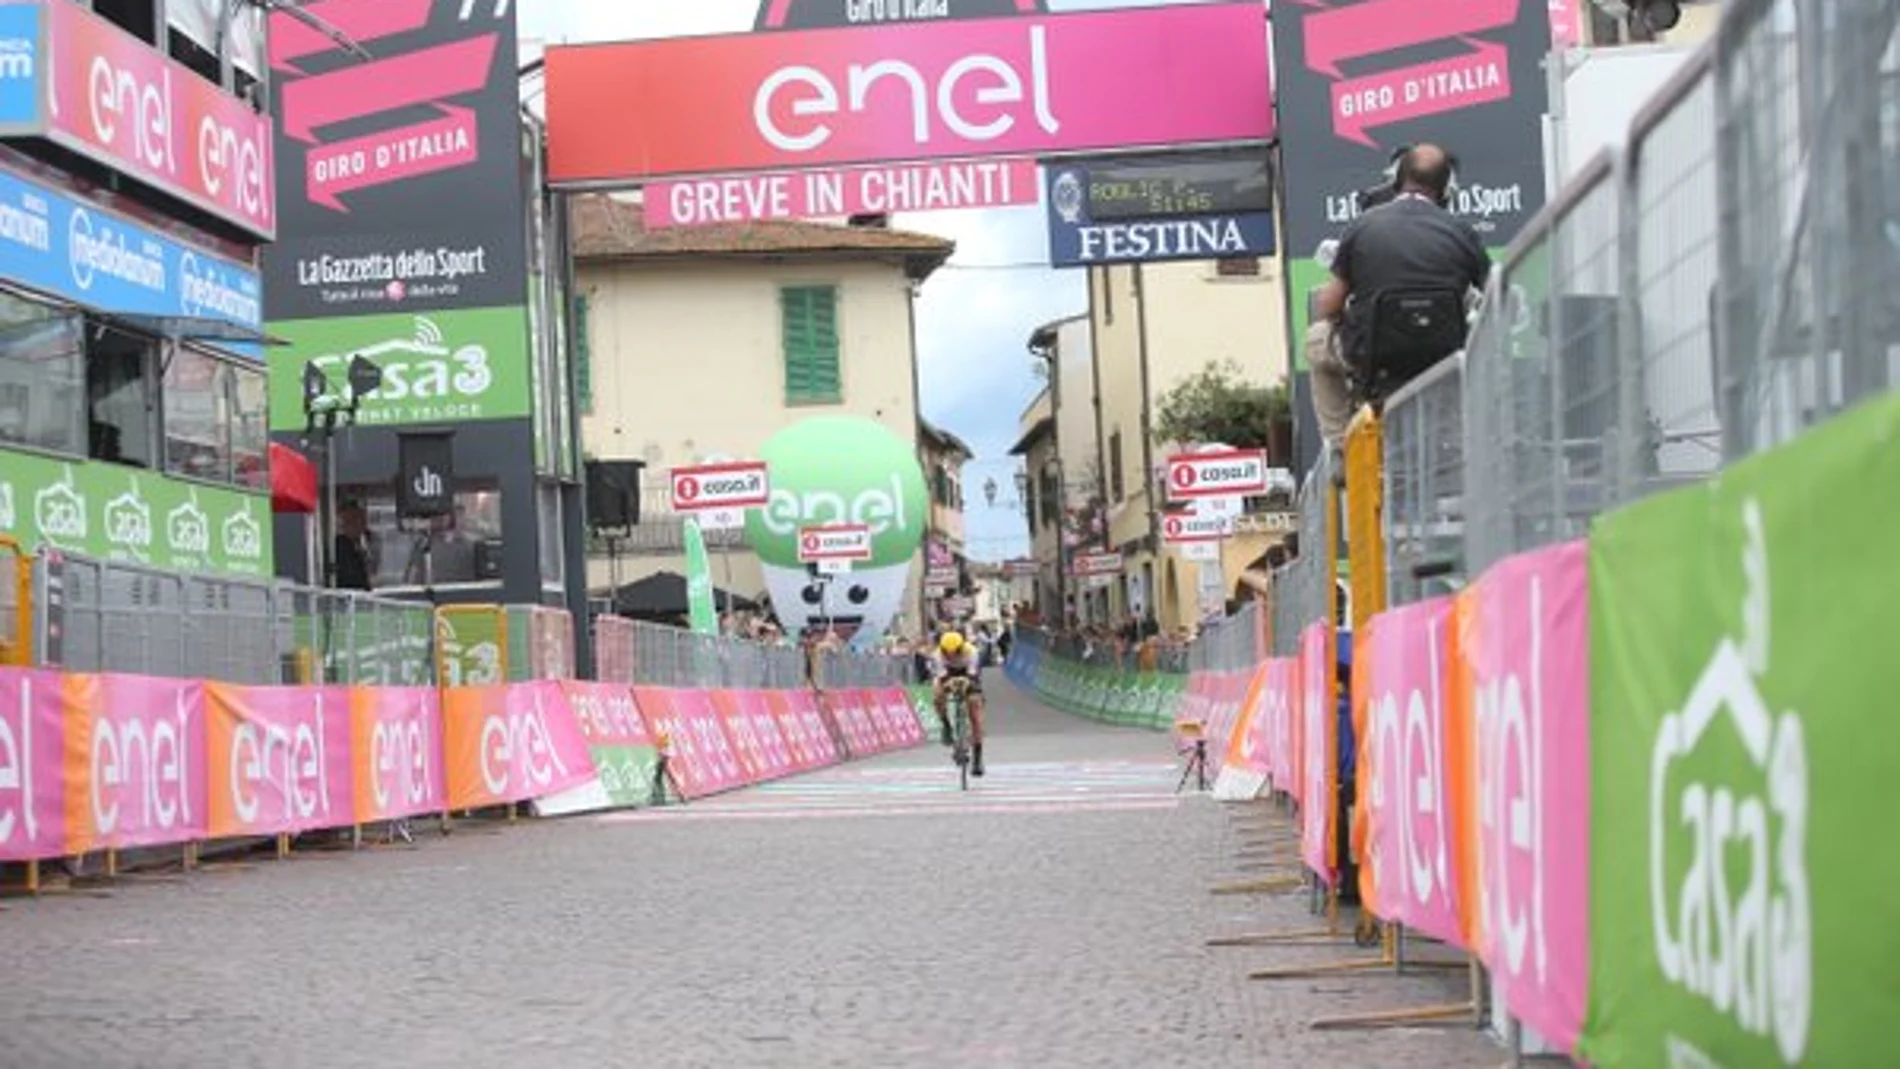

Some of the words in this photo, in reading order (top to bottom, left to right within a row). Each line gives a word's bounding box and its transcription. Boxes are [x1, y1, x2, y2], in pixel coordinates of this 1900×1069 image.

[89, 55, 176, 175] enel
[754, 25, 1059, 152] enel
[1340, 85, 1394, 118] GIRO
[1404, 62, 1500, 104] D'ITALIA
[199, 115, 268, 221] enel
[315, 151, 365, 182] GIRO
[376, 128, 468, 168] D'ITALIA
[670, 178, 790, 223] GREVE
[805, 175, 843, 214] IN
[860, 164, 1010, 211] CHIANTI
[1078, 217, 1248, 260] FESTINA
[1326, 194, 1349, 222] La
[1472, 183, 1522, 217] Sport
[298, 258, 319, 285] La
[320, 253, 394, 283] Gazzetta
[395, 249, 436, 280] dello
[436, 246, 486, 279] Sport
[761, 472, 908, 534] enel
[90, 688, 193, 834] enel
[230, 692, 331, 823] enel
[369, 697, 432, 807] enel
[480, 691, 568, 795] enel
[1476, 574, 1547, 988] el
